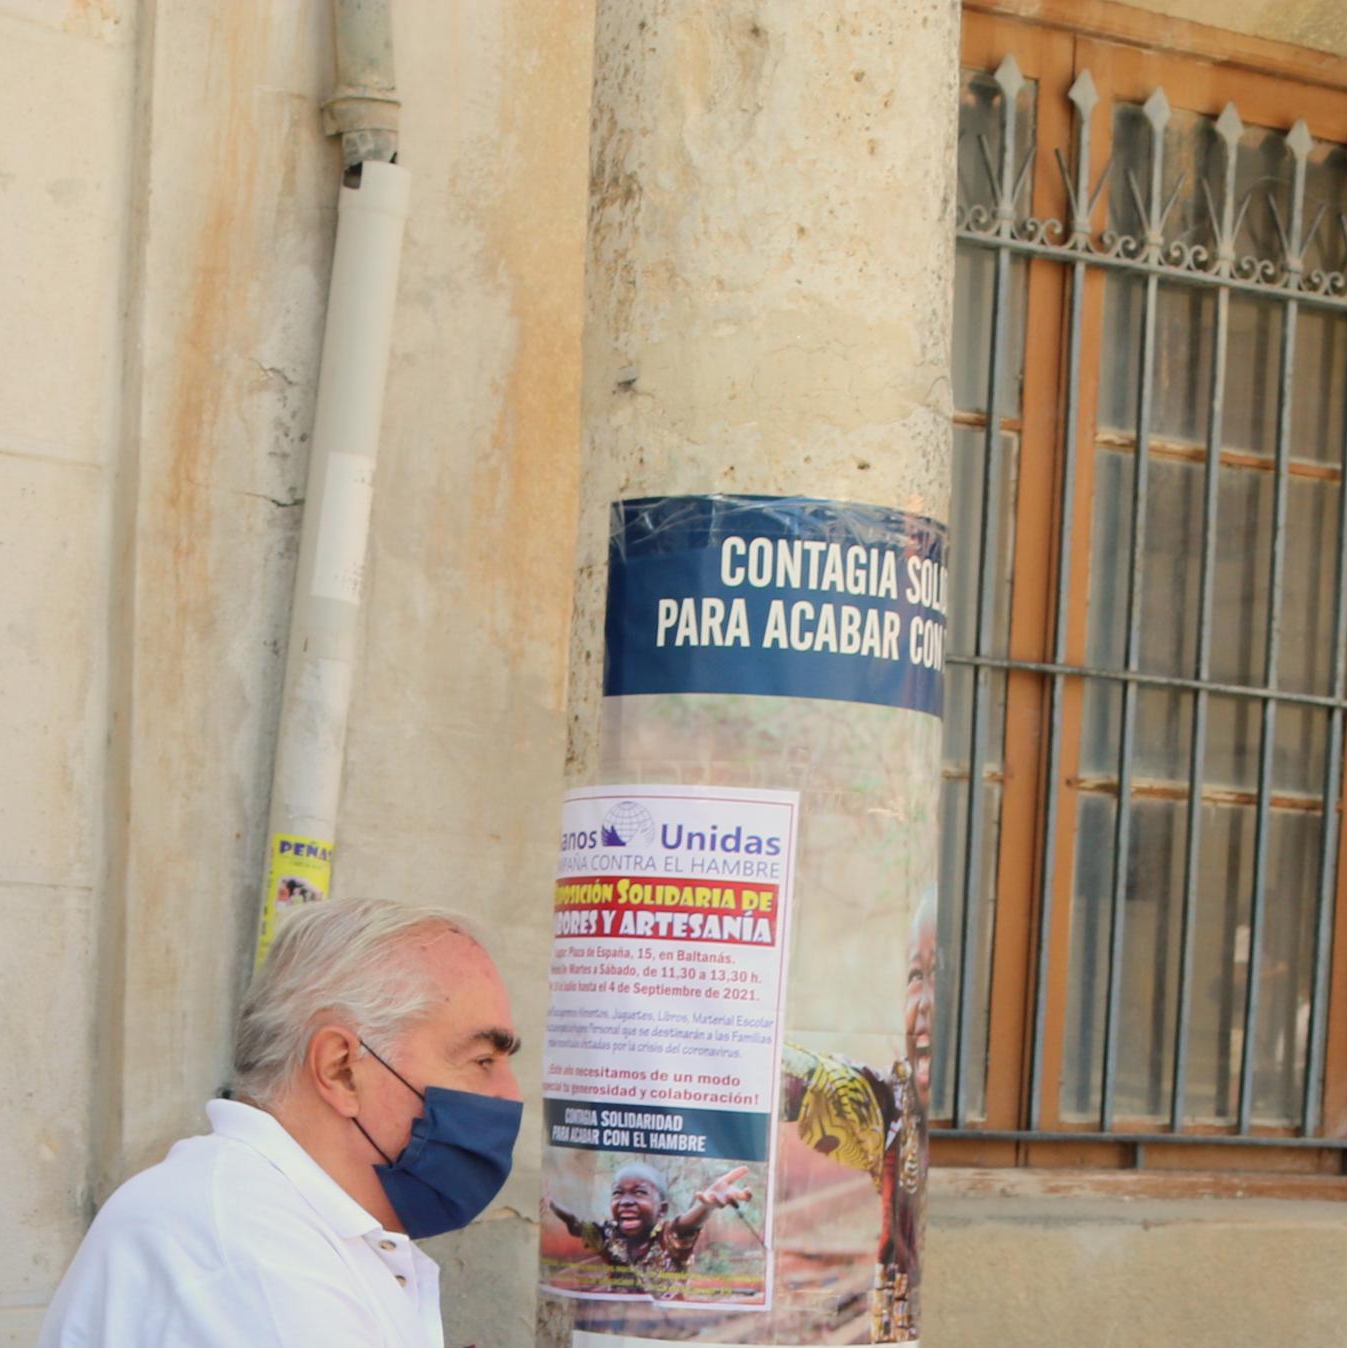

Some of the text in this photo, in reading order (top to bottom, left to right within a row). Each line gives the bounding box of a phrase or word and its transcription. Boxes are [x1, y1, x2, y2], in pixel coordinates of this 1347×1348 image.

[721, 536, 897, 599] CONTAGIA
[656, 598, 944, 671] PARA ACABAR CON
[561, 824, 780, 856] anos Unidas
[591, 854, 779, 879] CONTRA EL HAMBRE
[742, 890, 772, 912] DE
[602, 910, 772, 944] Y ARTESANÍA
[659, 951, 673, 961] en
[677, 950, 735, 965] Baltanás.
[599, 965, 762, 984] Sábado, de 11,30 13,30 h.
[609, 982, 759, 1001] 4 de Septiembre de 2021.
[692, 1013, 774, 1029] Material Escolar
[650, 1070, 740, 1087] de un modo
[639, 1087, 647, 1100] y
[650, 1087, 758, 1105] colaboración!
[601, 1110, 683, 1131] SOLIDARIDAD
[603, 1129, 706, 1152] CON EL HAMBRE
